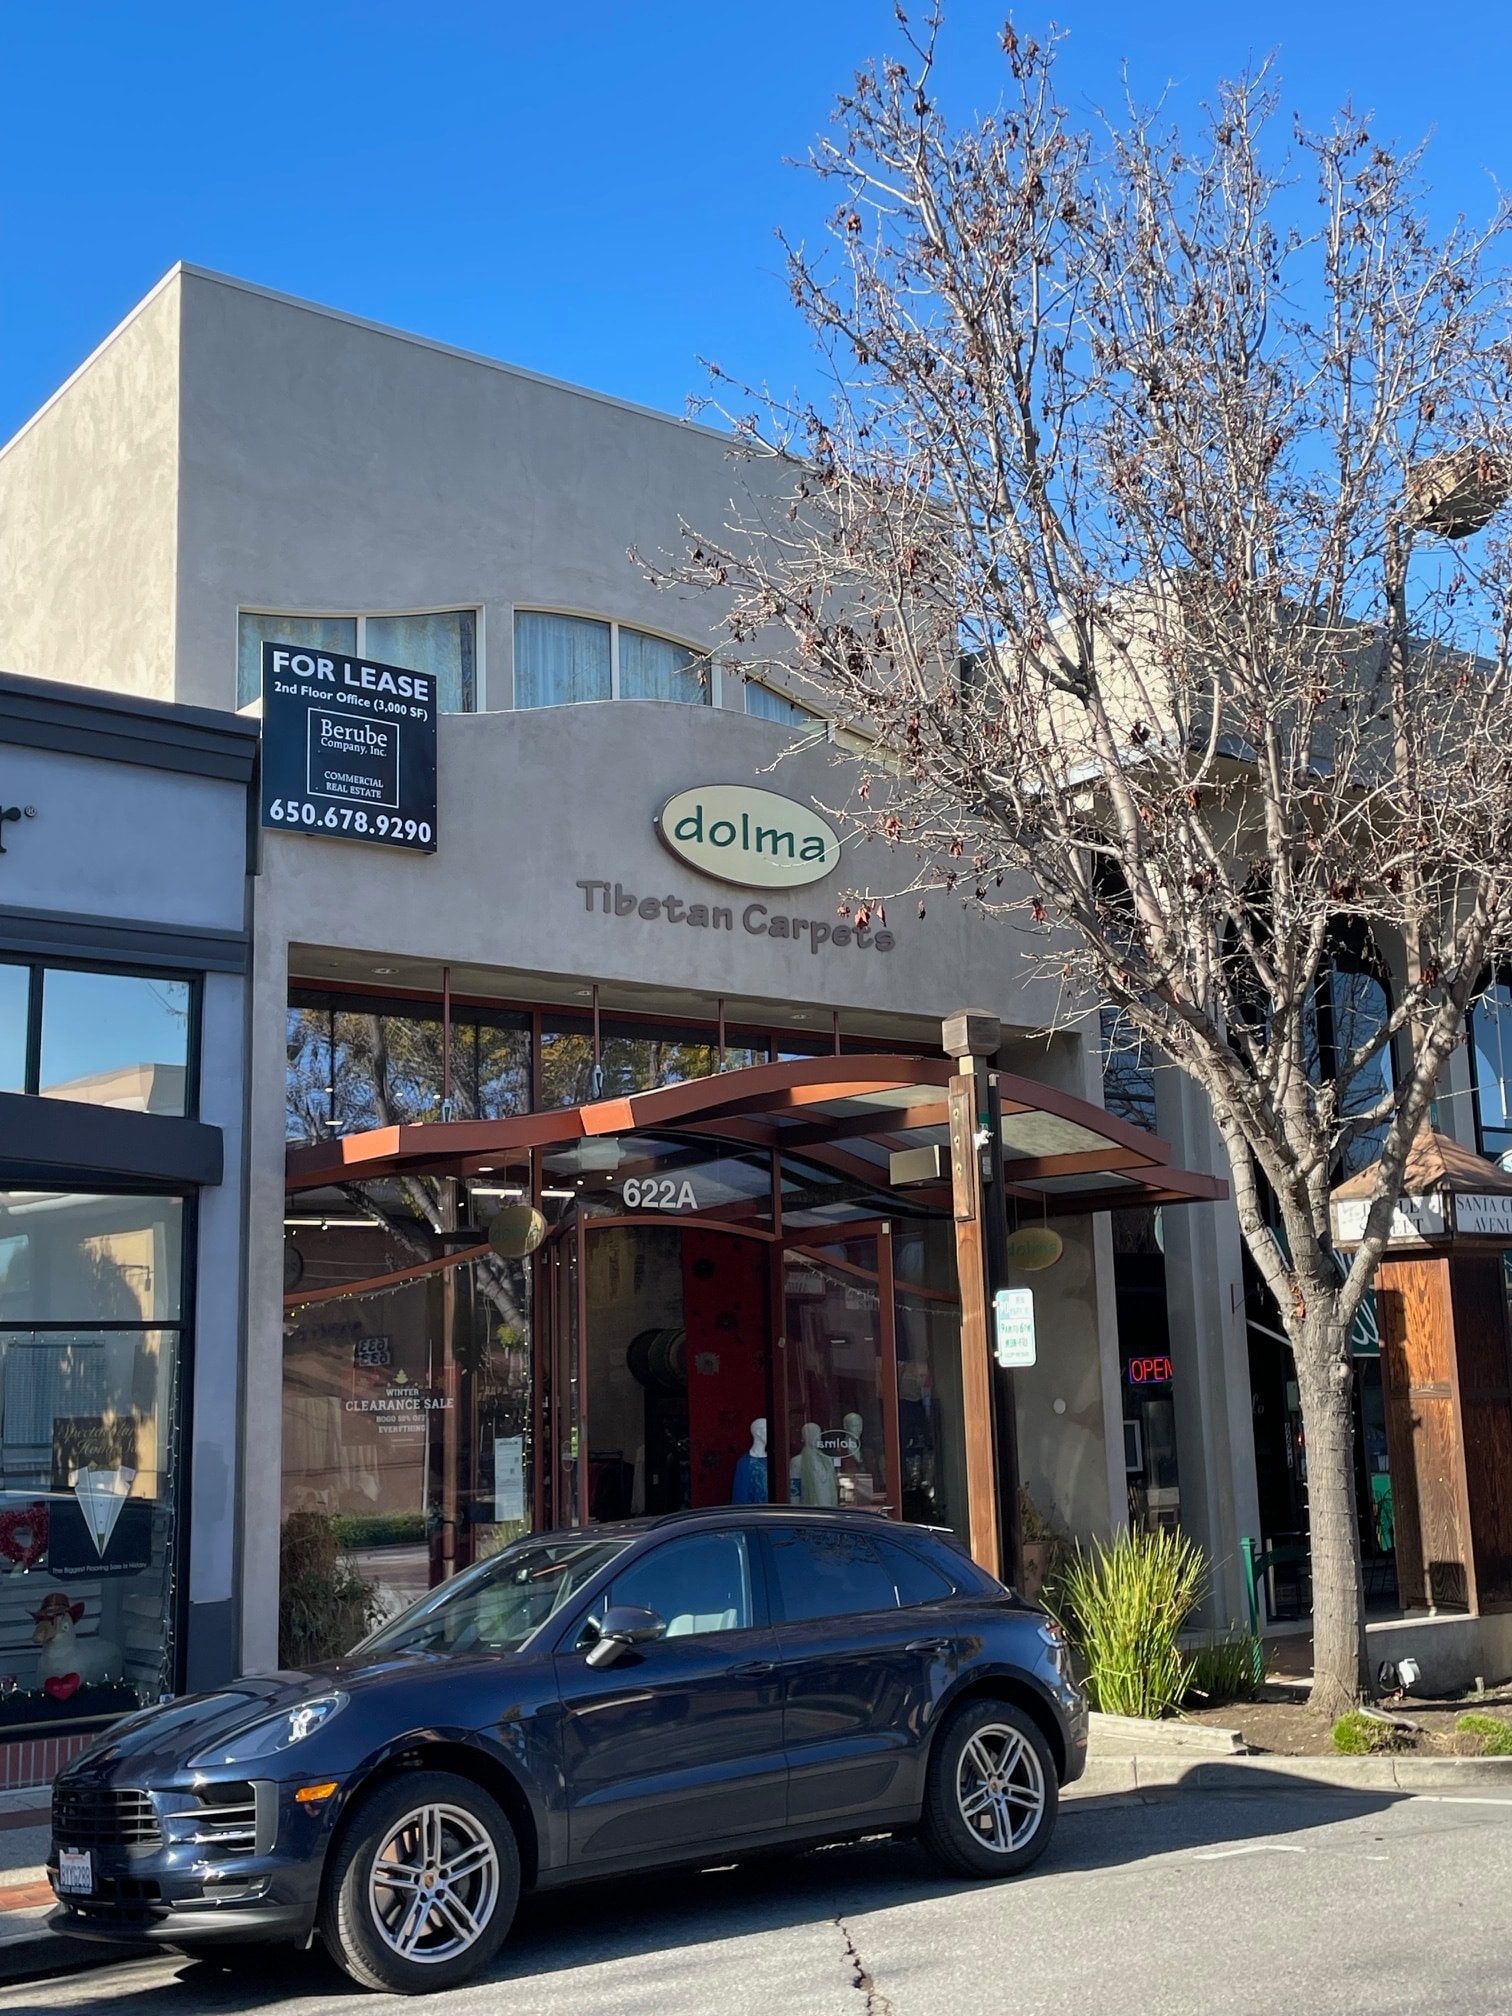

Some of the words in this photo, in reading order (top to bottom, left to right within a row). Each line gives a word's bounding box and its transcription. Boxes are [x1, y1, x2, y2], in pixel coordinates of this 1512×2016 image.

[272, 651, 336, 682] FOR
[344, 663, 429, 702] LEASE
[274, 681, 297, 695] 2nd
[301, 685, 333, 701] Floor
[336, 692, 371, 708] Office
[374, 699, 407, 716] (3,000
[409, 705, 428, 722] SF)
[320, 718, 388, 747] Berube
[320, 737, 368, 756] Company,
[370, 747, 387, 757] Inc.
[324, 770, 384, 788] COMMERCIAL
[326, 782, 348, 794] REAL
[350, 786, 382, 799] ESTATE
[270, 798, 432, 843] 650.678.9290
[674, 804, 826, 863] dolma
[575, 879, 733, 931] Tibetan
[742, 903, 896, 954] Carpets
[622, 1178, 698, 1210] 622A
[1456, 1195, 1497, 1213] SANTA
[1501, 1198, 1512, 1214] C
[1132, 1358, 1173, 1382] OPEN
[386, 1388, 419, 1397] WINTER
[346, 1399, 420, 1412] CLEARANCE
[424, 1398, 454, 1410] SALE
[376, 1415, 396, 1423] BOGO
[378, 1424, 426, 1434] EVERYTHING
